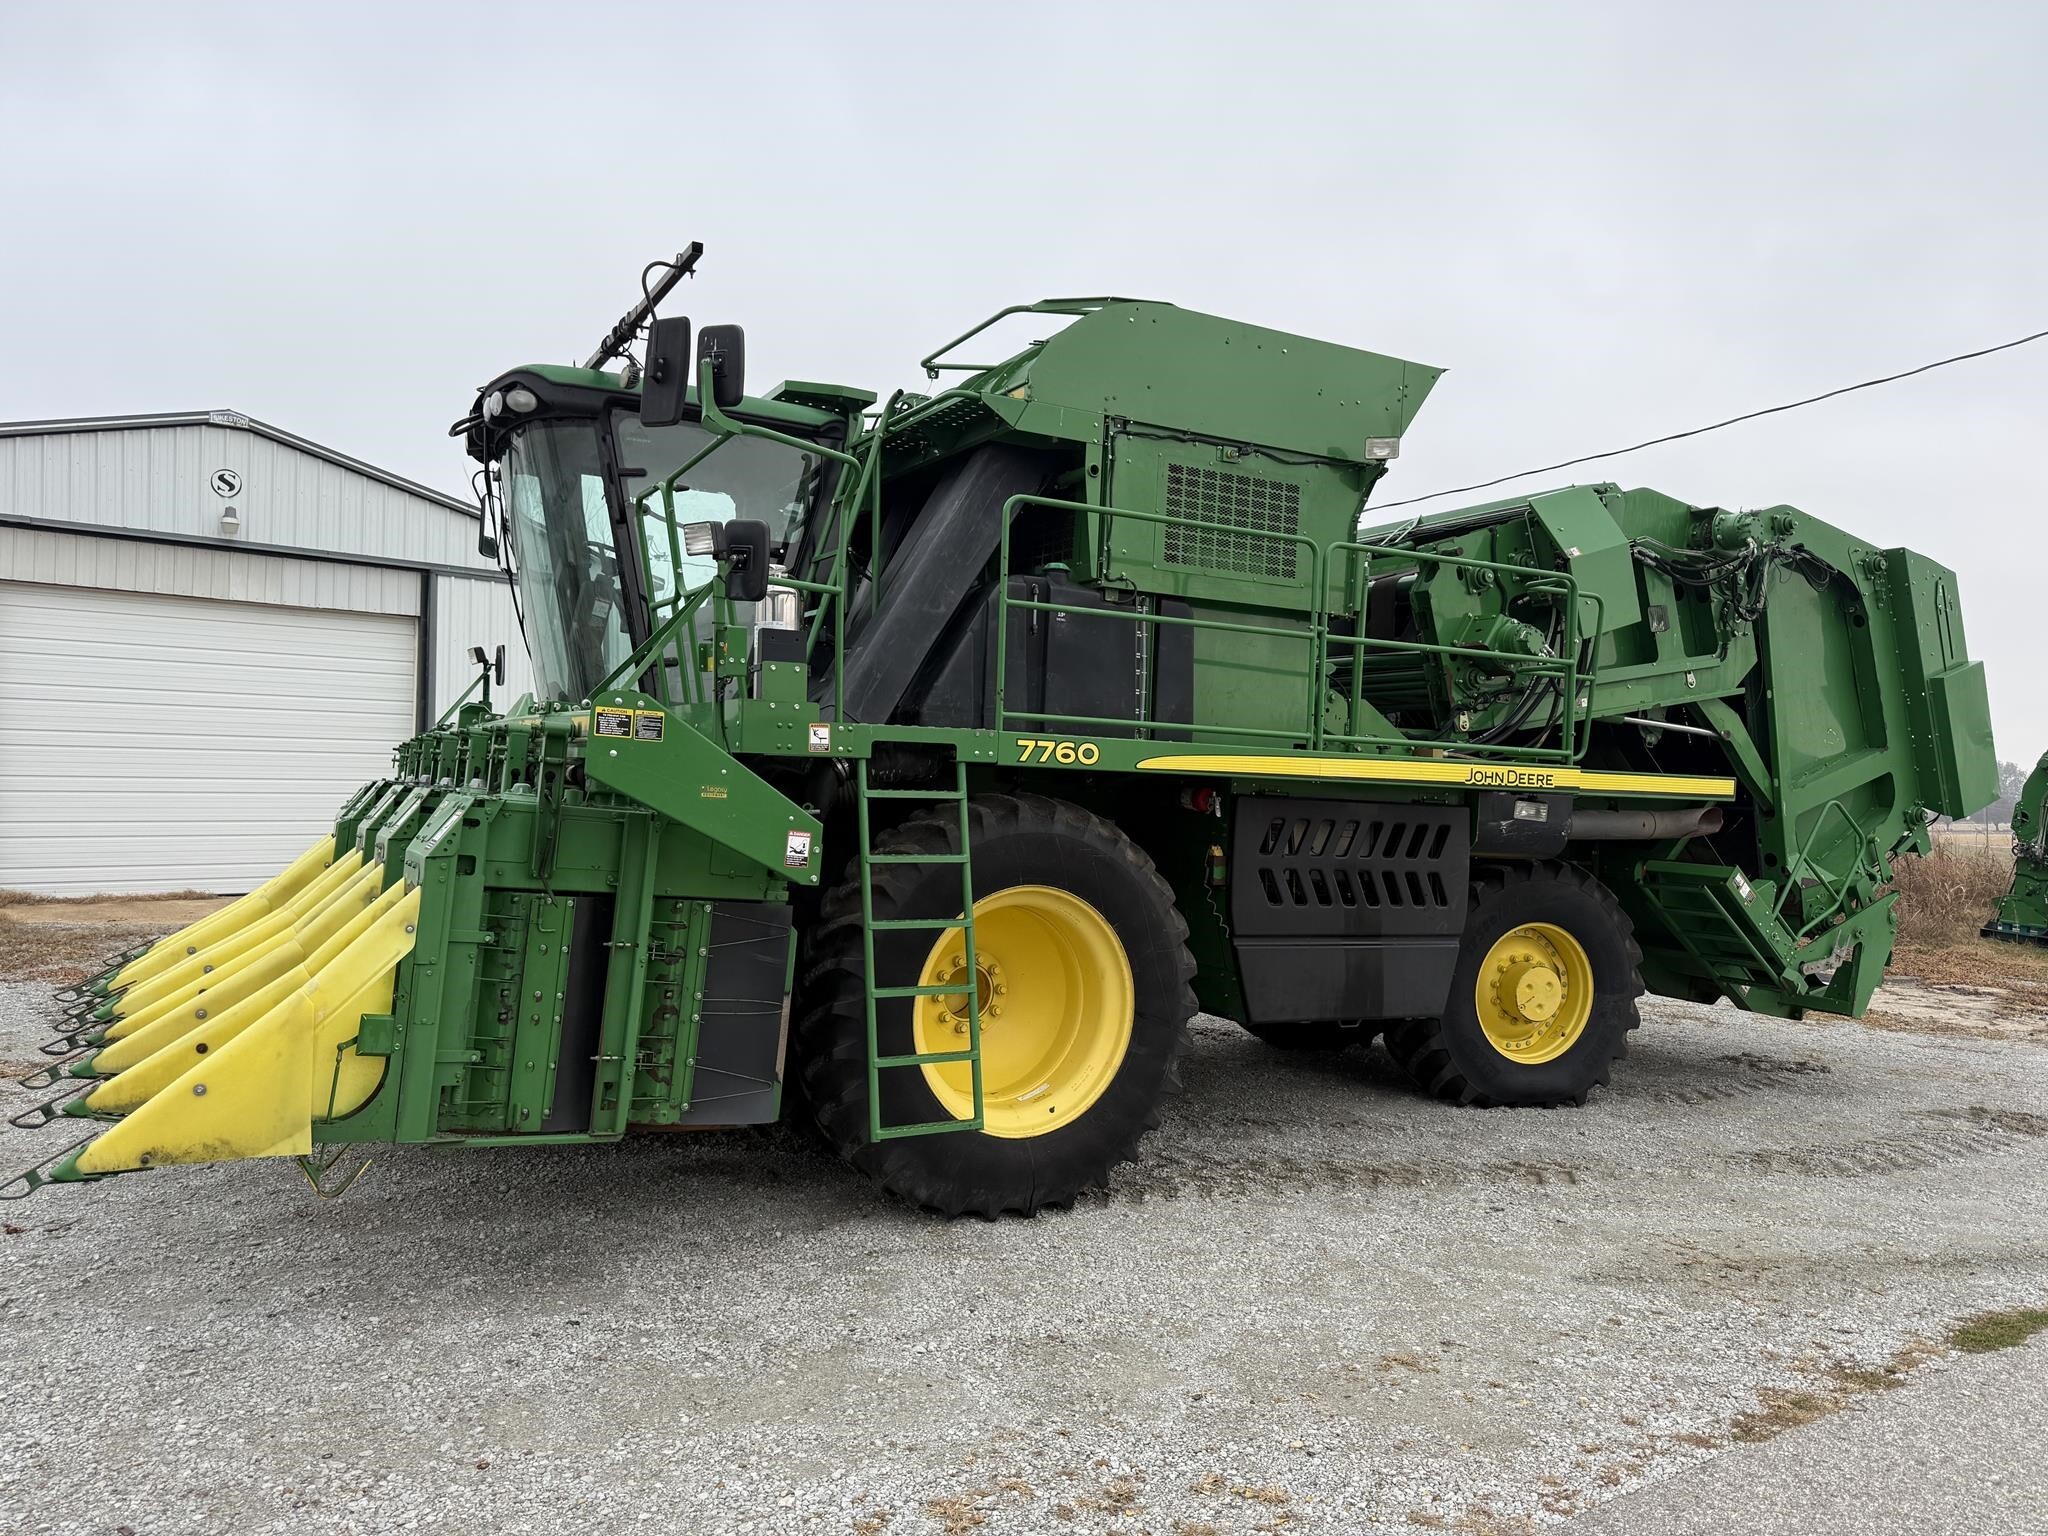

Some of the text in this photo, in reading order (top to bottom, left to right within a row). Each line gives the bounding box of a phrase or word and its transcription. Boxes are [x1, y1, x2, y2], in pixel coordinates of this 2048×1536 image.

[217, 473, 236, 492] S
[1016, 738, 1100, 766] 7760
[1465, 768, 1555, 787] JOHN DEERE
